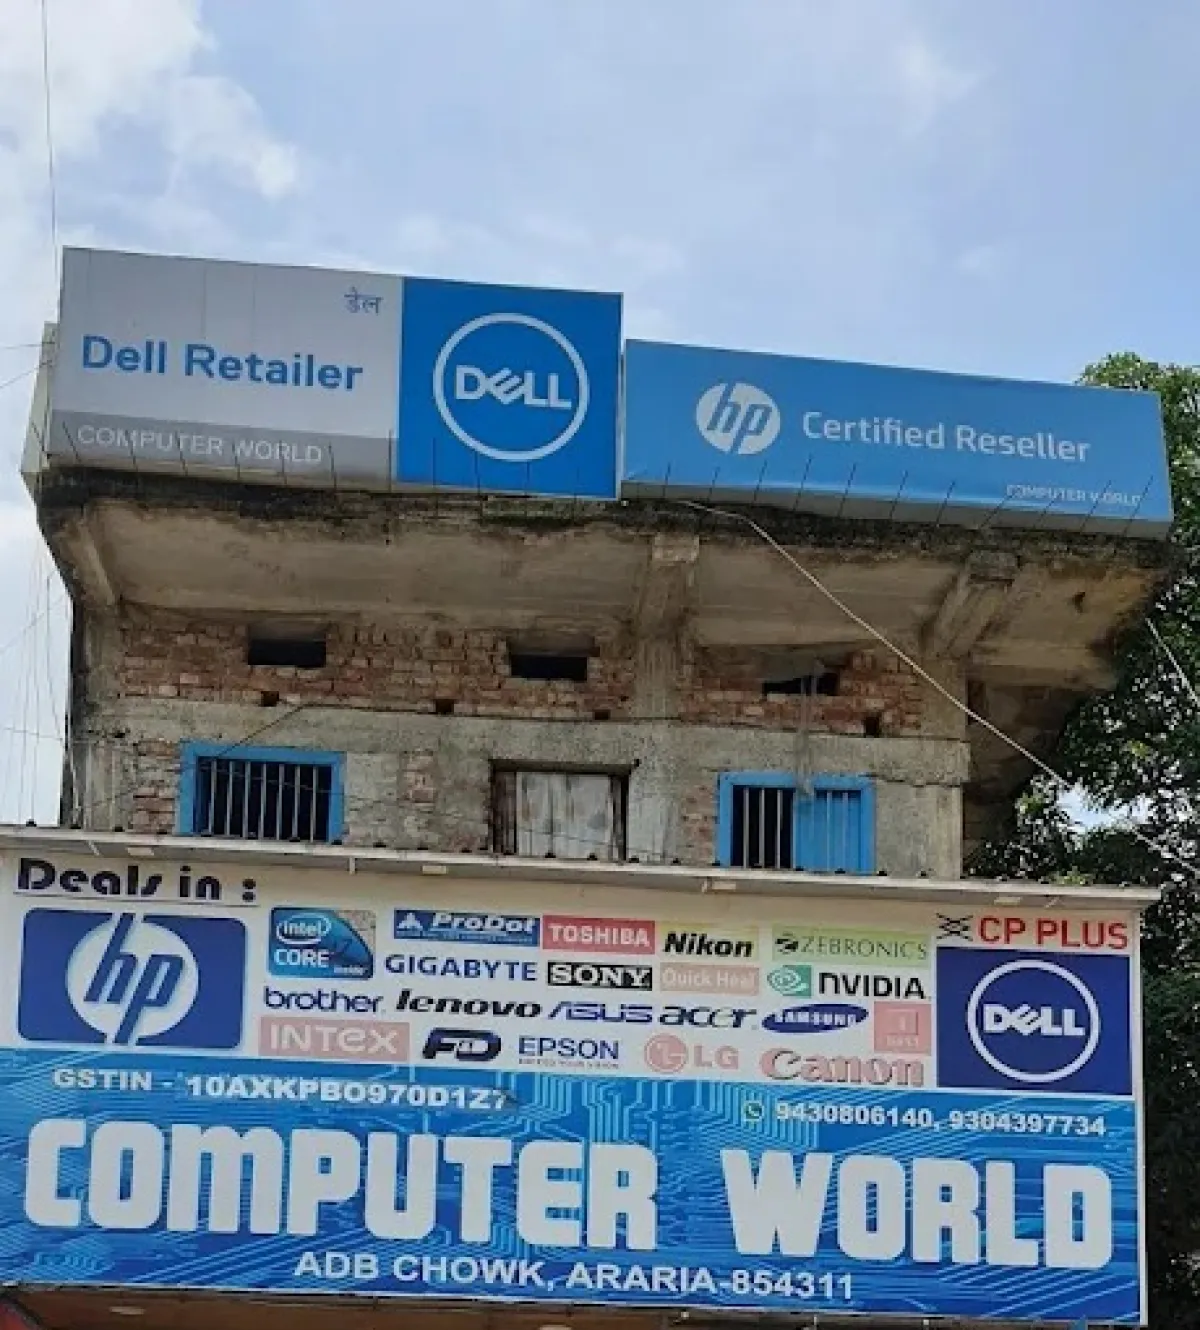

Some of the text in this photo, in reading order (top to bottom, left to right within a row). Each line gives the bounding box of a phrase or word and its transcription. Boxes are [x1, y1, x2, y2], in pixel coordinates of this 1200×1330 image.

[82, 334, 363, 391] Dell Retailer
[455, 365, 572, 409] DELL
[703, 384, 774, 454] hp
[76, 424, 322, 464] COMPUTER WORLD
[802, 411, 1090, 462] Certified Reseller
[17, 857, 163, 897] Deals
[179, 865, 222, 901] in
[550, 925, 650, 948] TOSHIBA
[664, 931, 752, 958] Nikon
[978, 916, 1128, 950] CP PLUS
[274, 950, 331, 968] CORE
[801, 935, 928, 961] ZEBRONICS
[83, 912, 184, 1045] hp
[385, 954, 539, 982] GIGABYTE
[550, 964, 651, 988] SONY
[662, 967, 711, 988] Quick
[263, 986, 383, 1013] brother
[396, 989, 541, 1018] lenovo
[548, 1001, 652, 1024] ASUS
[659, 1005, 757, 1029] acer
[775, 1010, 857, 1027] SAMSUNG
[982, 1003, 1086, 1036] DELL
[518, 1036, 619, 1060] EPSON
[693, 1045, 739, 1070] LG
[53, 1068, 153, 1091] GSTIN
[759, 1047, 924, 1088] Canon
[775, 1102, 941, 1131] 9430806140,
[24, 1117, 1113, 1269] COMPUTER WORLD
[294, 1252, 853, 1300] ADB CHOWK, ARARIA-854311
